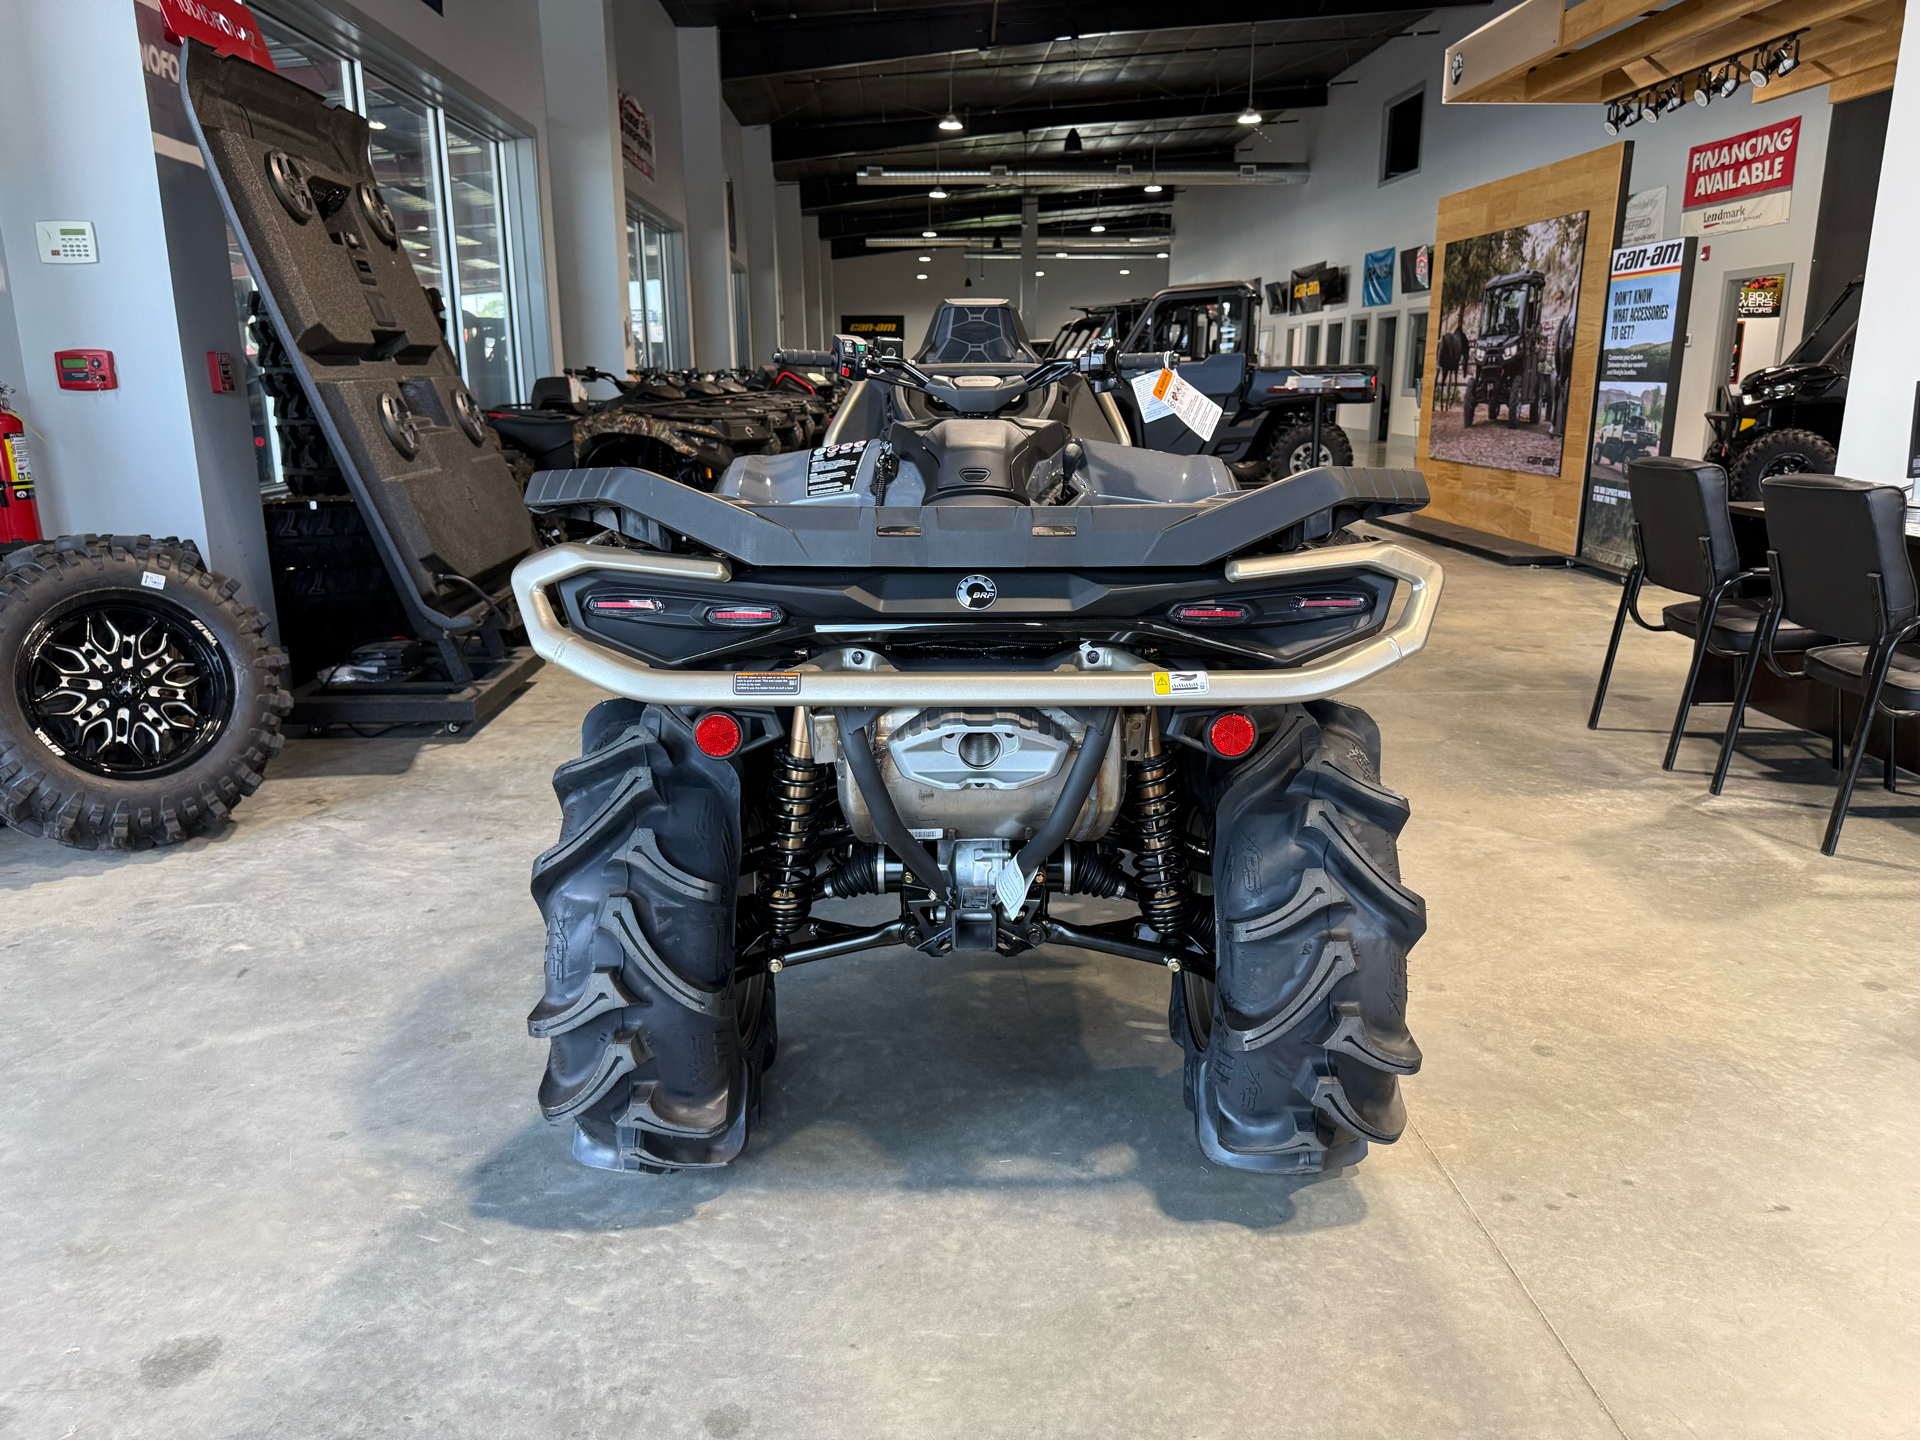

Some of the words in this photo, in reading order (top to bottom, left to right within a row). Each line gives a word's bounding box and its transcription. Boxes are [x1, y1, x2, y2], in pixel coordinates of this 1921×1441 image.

[1691, 128, 1793, 174] FINANCING
[1694, 156, 1784, 198] AVAILABLE
[1703, 205, 1746, 223] Lendmark
[1614, 290, 1633, 306] DON'T
[1634, 288, 1653, 304] KNOW
[1749, 291, 1774, 299] BOY
[1613, 308, 1629, 323] WHAT
[1630, 304, 1669, 321] ACCESSORIES
[849, 323, 897, 332] can-am
[1611, 326, 1619, 340] TO
[1620, 325, 1635, 340] GET?
[972, 591, 995, 599] BRP
[1241, 831, 1263, 895] XPS
